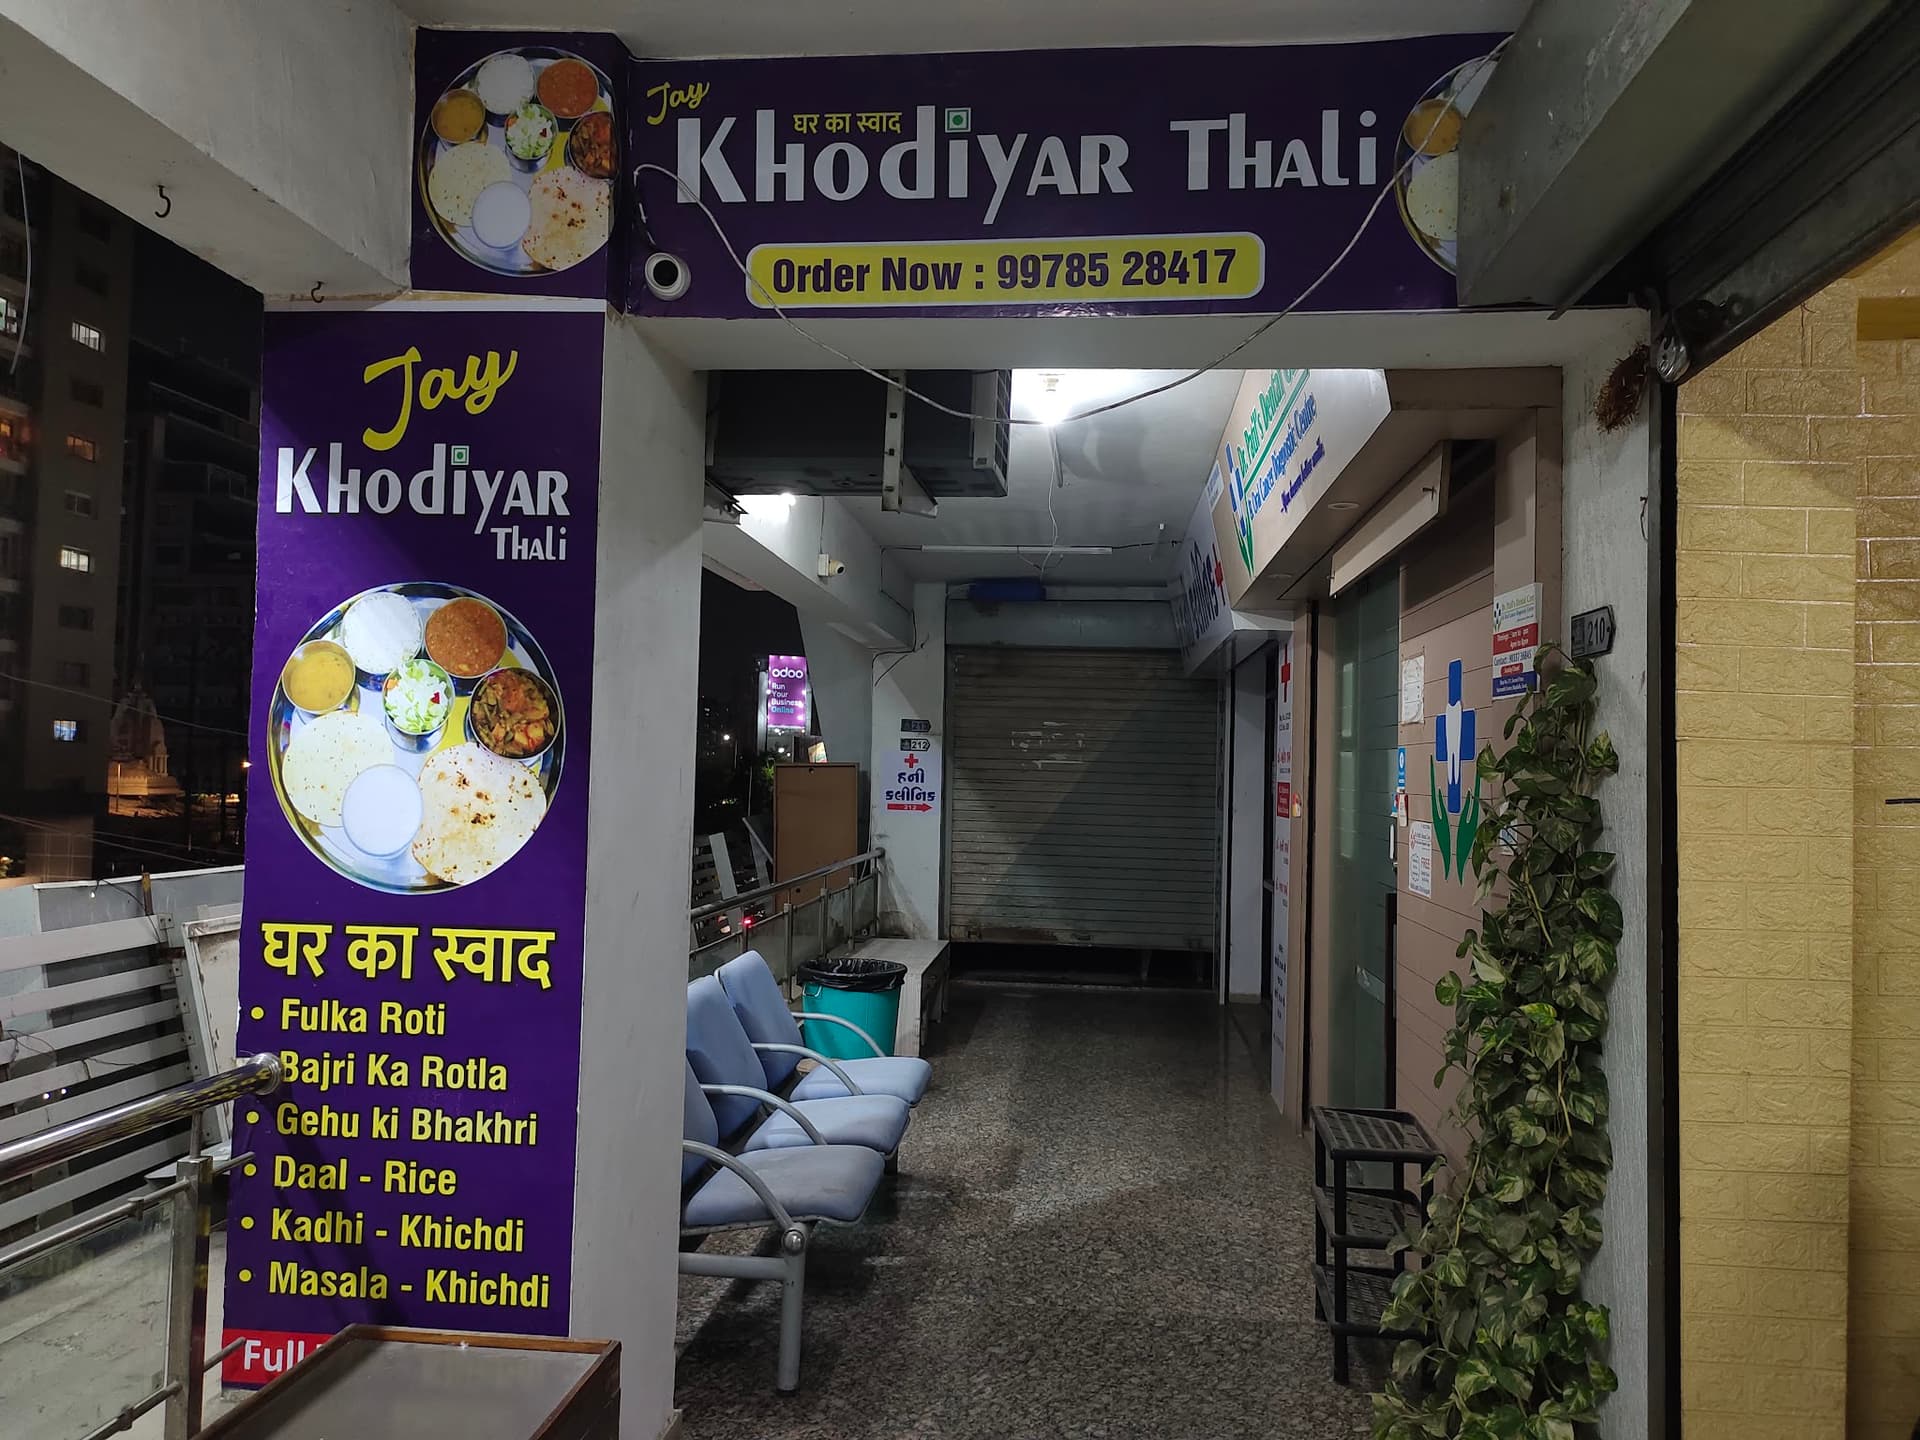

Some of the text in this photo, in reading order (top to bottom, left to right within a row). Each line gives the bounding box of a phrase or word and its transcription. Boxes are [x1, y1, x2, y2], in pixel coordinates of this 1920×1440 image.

[647, 81, 709, 126] Jay
[794, 112, 902, 135] घर का स्वाद
[773, 258, 870, 293] Order
[883, 259, 962, 291] Now
[998, 253, 1110, 289] 99785
[1122, 248, 1236, 286] 28417
[363, 346, 518, 451] Jay
[1588, 617, 1605, 646] 210
[772, 667, 803, 679] odoo
[772, 682, 786, 690] Run
[771, 706, 794, 714] Online
[772, 690, 788, 698] Your
[912, 741, 928, 749] 212
[897, 768, 925, 784] હની
[262, 923, 555, 989] घर का स्वाद
[281, 998, 445, 1035] Fulka Roti
[280, 1051, 507, 1091] Bajri Ka Rotla
[277, 1103, 537, 1145] Gehu ki Bhakhri
[274, 1156, 347, 1191] Daal
[384, 1161, 456, 1195] Rice
[271, 1208, 363, 1245] Kadhi
[400, 1215, 524, 1252] Khichdi
[269, 1261, 387, 1300] Masala
[426, 1269, 549, 1308] Khichdi
[244, 1339, 304, 1371] Full
